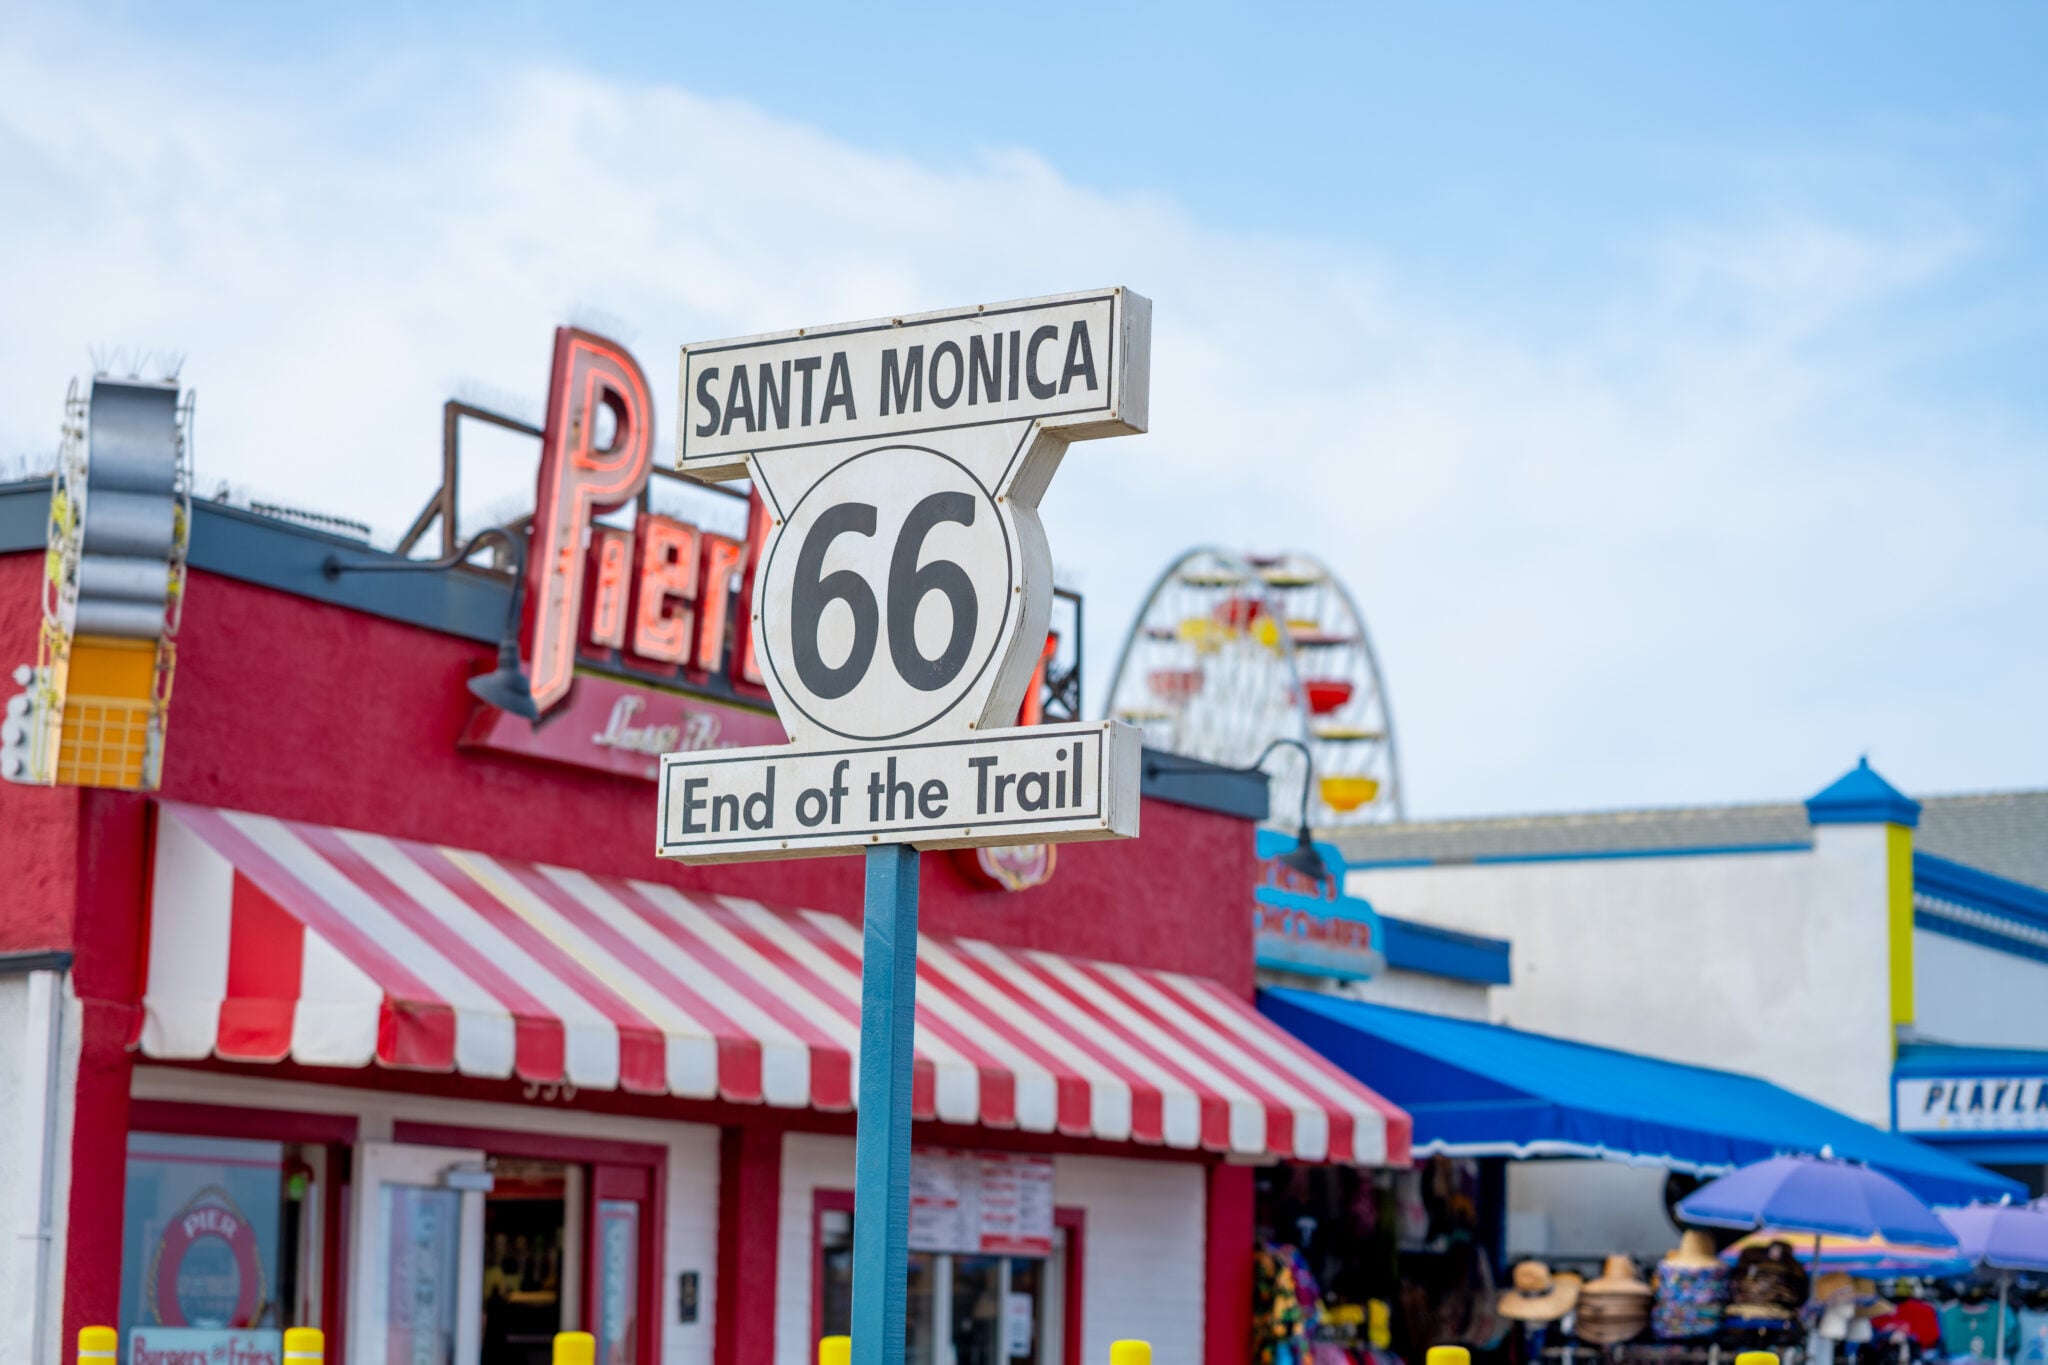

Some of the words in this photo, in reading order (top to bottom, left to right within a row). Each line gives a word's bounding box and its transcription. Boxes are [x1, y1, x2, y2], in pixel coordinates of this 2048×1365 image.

[696, 351, 857, 438] SANTA
[880, 319, 1099, 417] MONICA
[528, 327, 747, 713] Pier
[790, 491, 979, 700] 66
[682, 765, 776, 835] End
[795, 759, 850, 828] of
[867, 756, 949, 822] the
[968, 741, 1083, 815] Trail
[183, 1208, 238, 1239] PIER
[133, 1335, 207, 1365] Burgers
